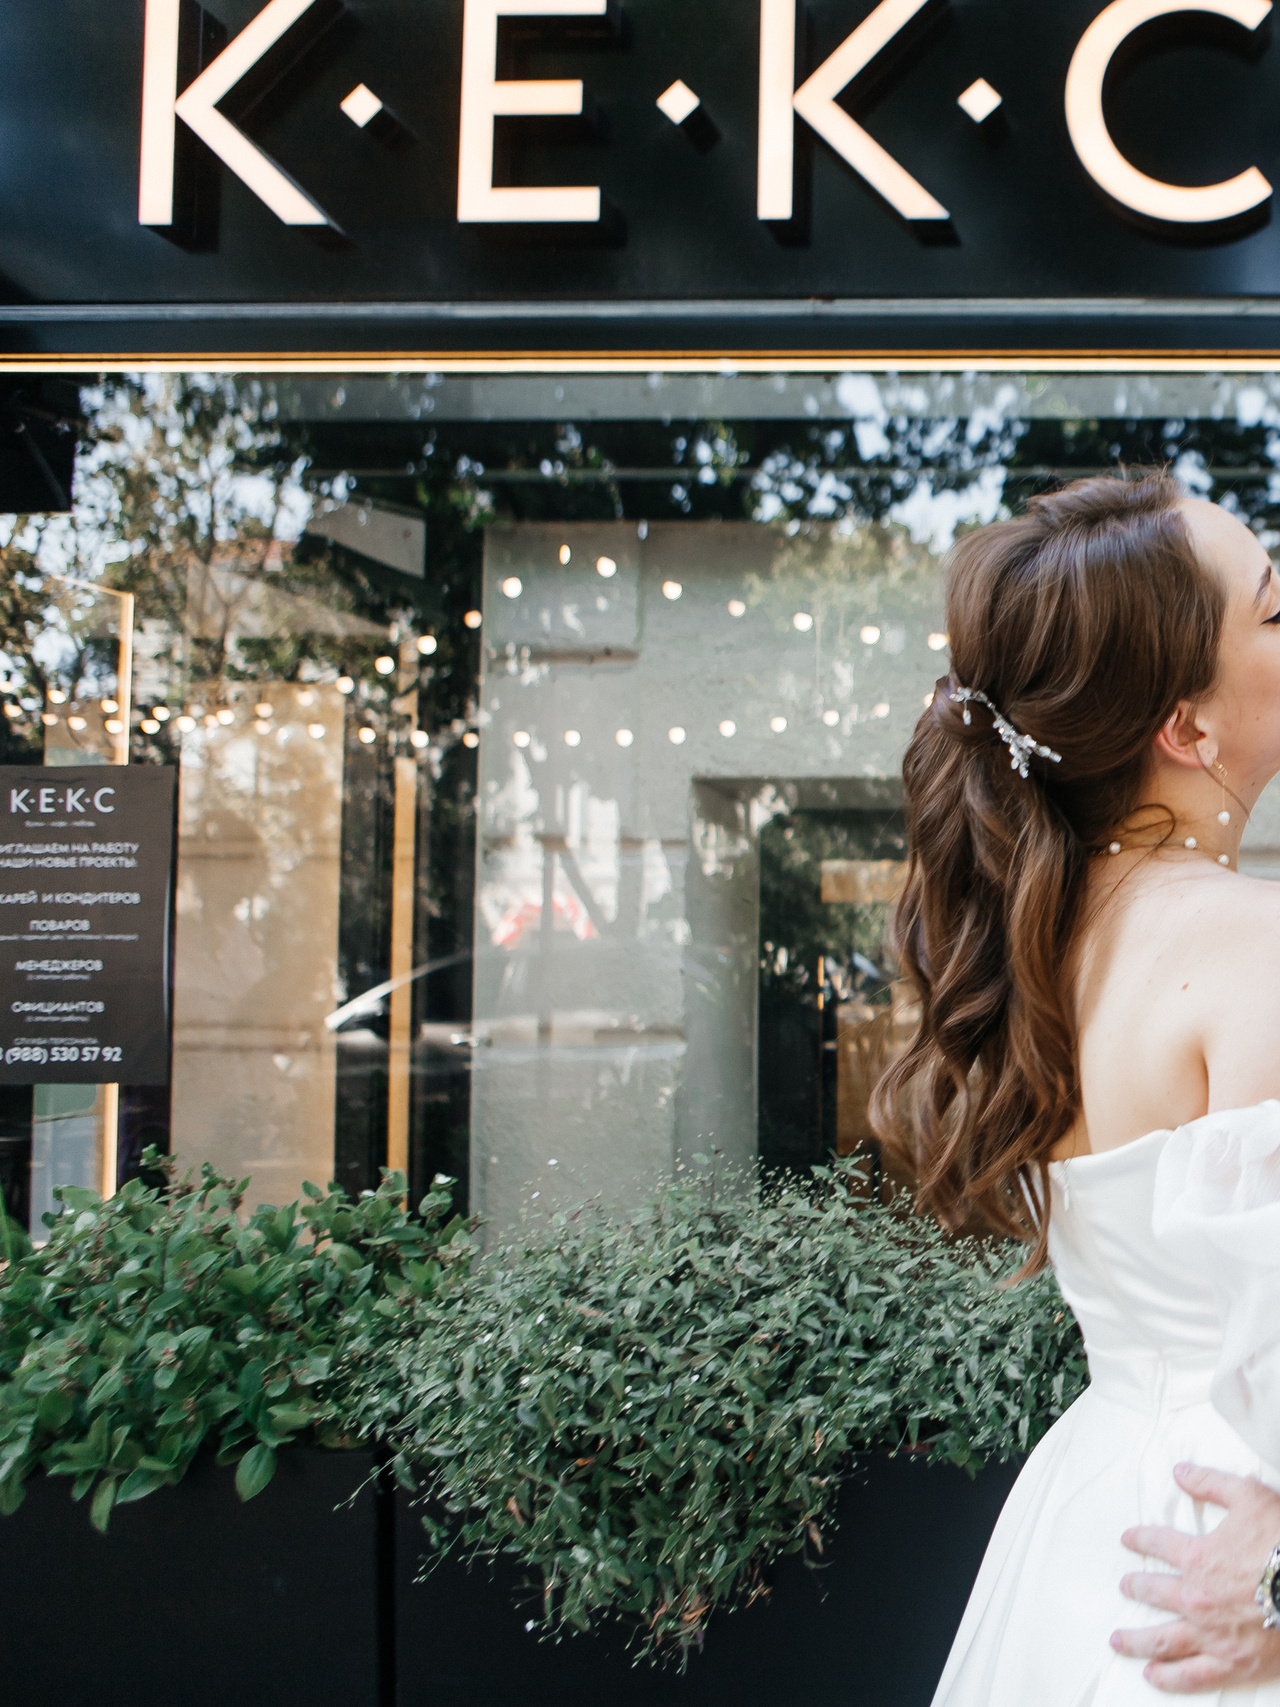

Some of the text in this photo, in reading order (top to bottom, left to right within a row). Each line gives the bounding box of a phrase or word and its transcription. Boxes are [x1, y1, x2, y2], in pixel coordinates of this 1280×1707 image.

[71, 843, 90, 854] НА
[91, 842, 140, 854] РАБОТУ
[35, 856, 78, 868] НОВЫЕ
[42, 893, 54, 904] И
[55, 892, 141, 905] КОНДИТЕРОВ
[29, 919, 91, 931] ПОВАРОВ
[15, 959, 103, 973] МЕНЕДЖЕРОВ
[11, 1001, 105, 1014] ОФИЦИАНТОВ
[49, 1046, 80, 1061] 530
[80, 1046, 101, 1061] 57
[101, 1046, 123, 1061] 92
